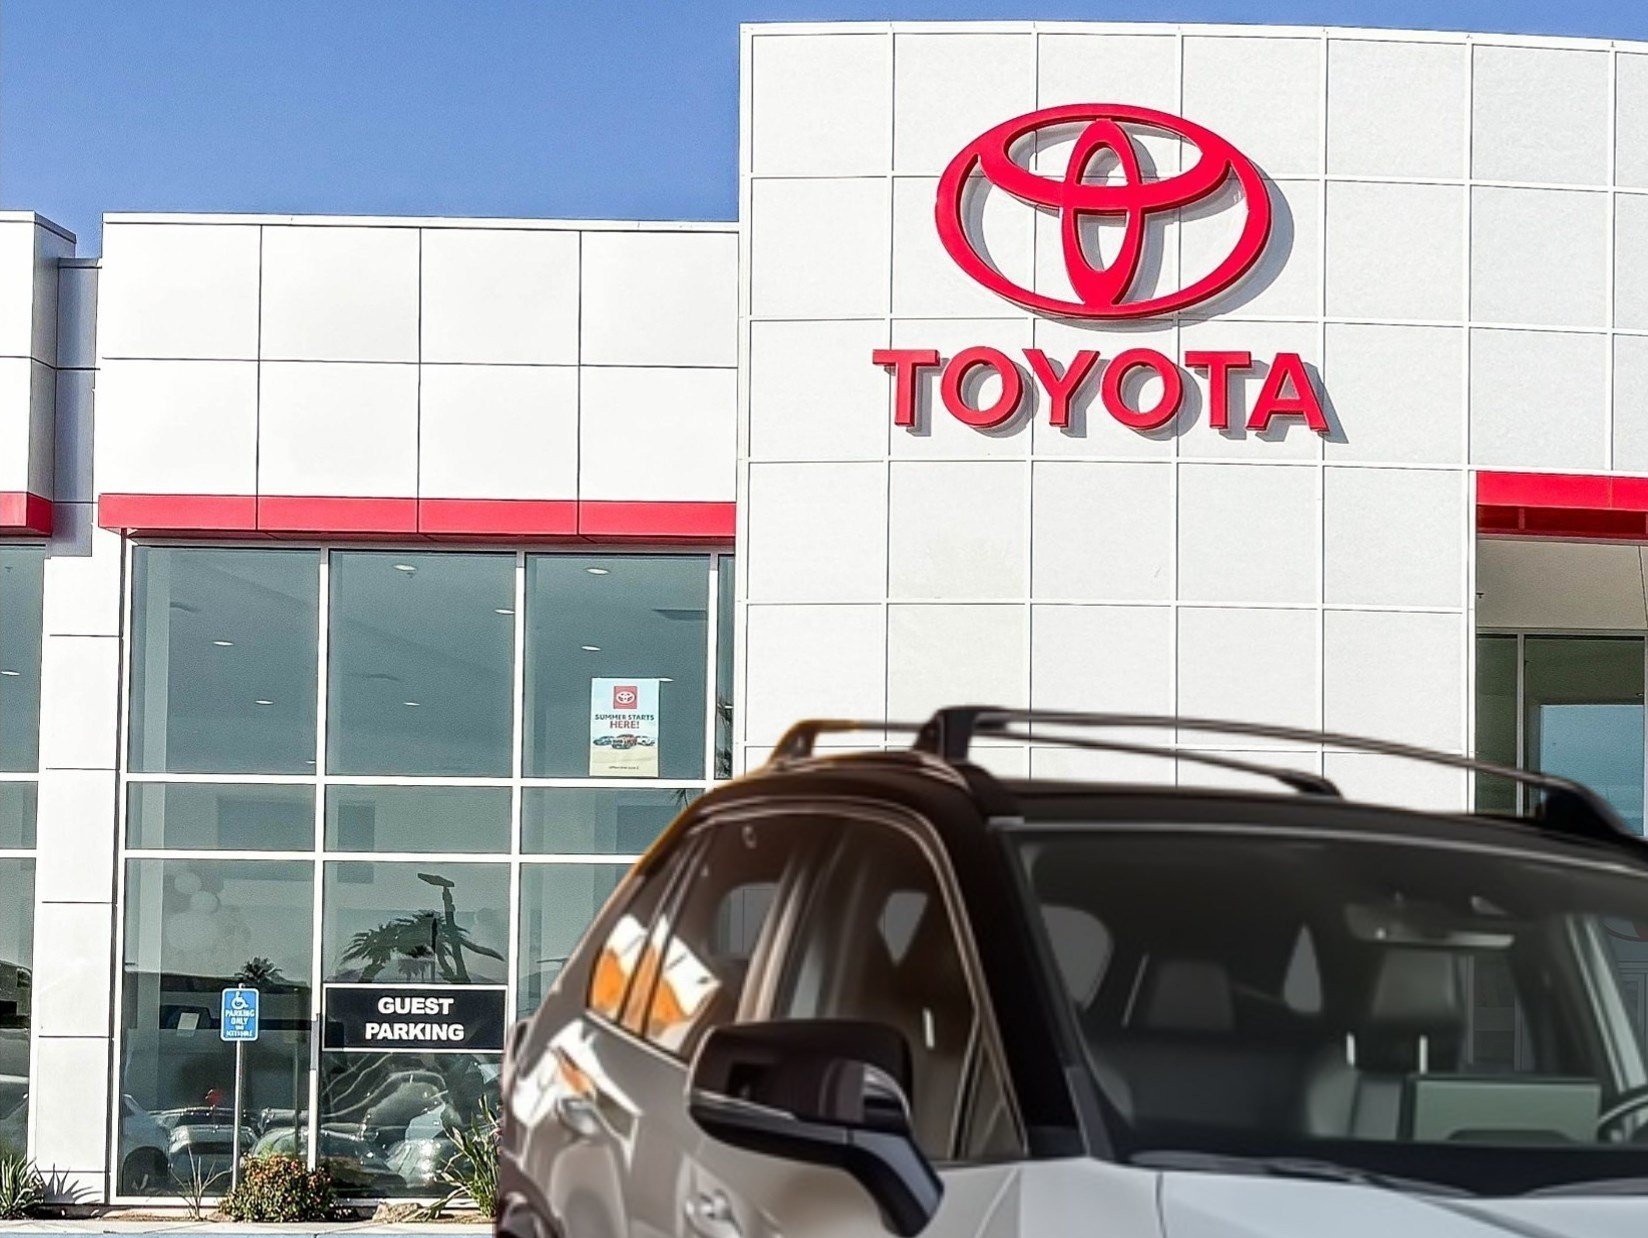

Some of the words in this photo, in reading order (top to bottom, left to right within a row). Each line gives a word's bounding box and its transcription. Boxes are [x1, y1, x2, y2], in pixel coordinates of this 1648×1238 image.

[873, 346, 1330, 433] TOYOTA
[609, 720, 640, 729] HERE!
[377, 996, 455, 1015] GUEST
[365, 1022, 465, 1041] PARKING
